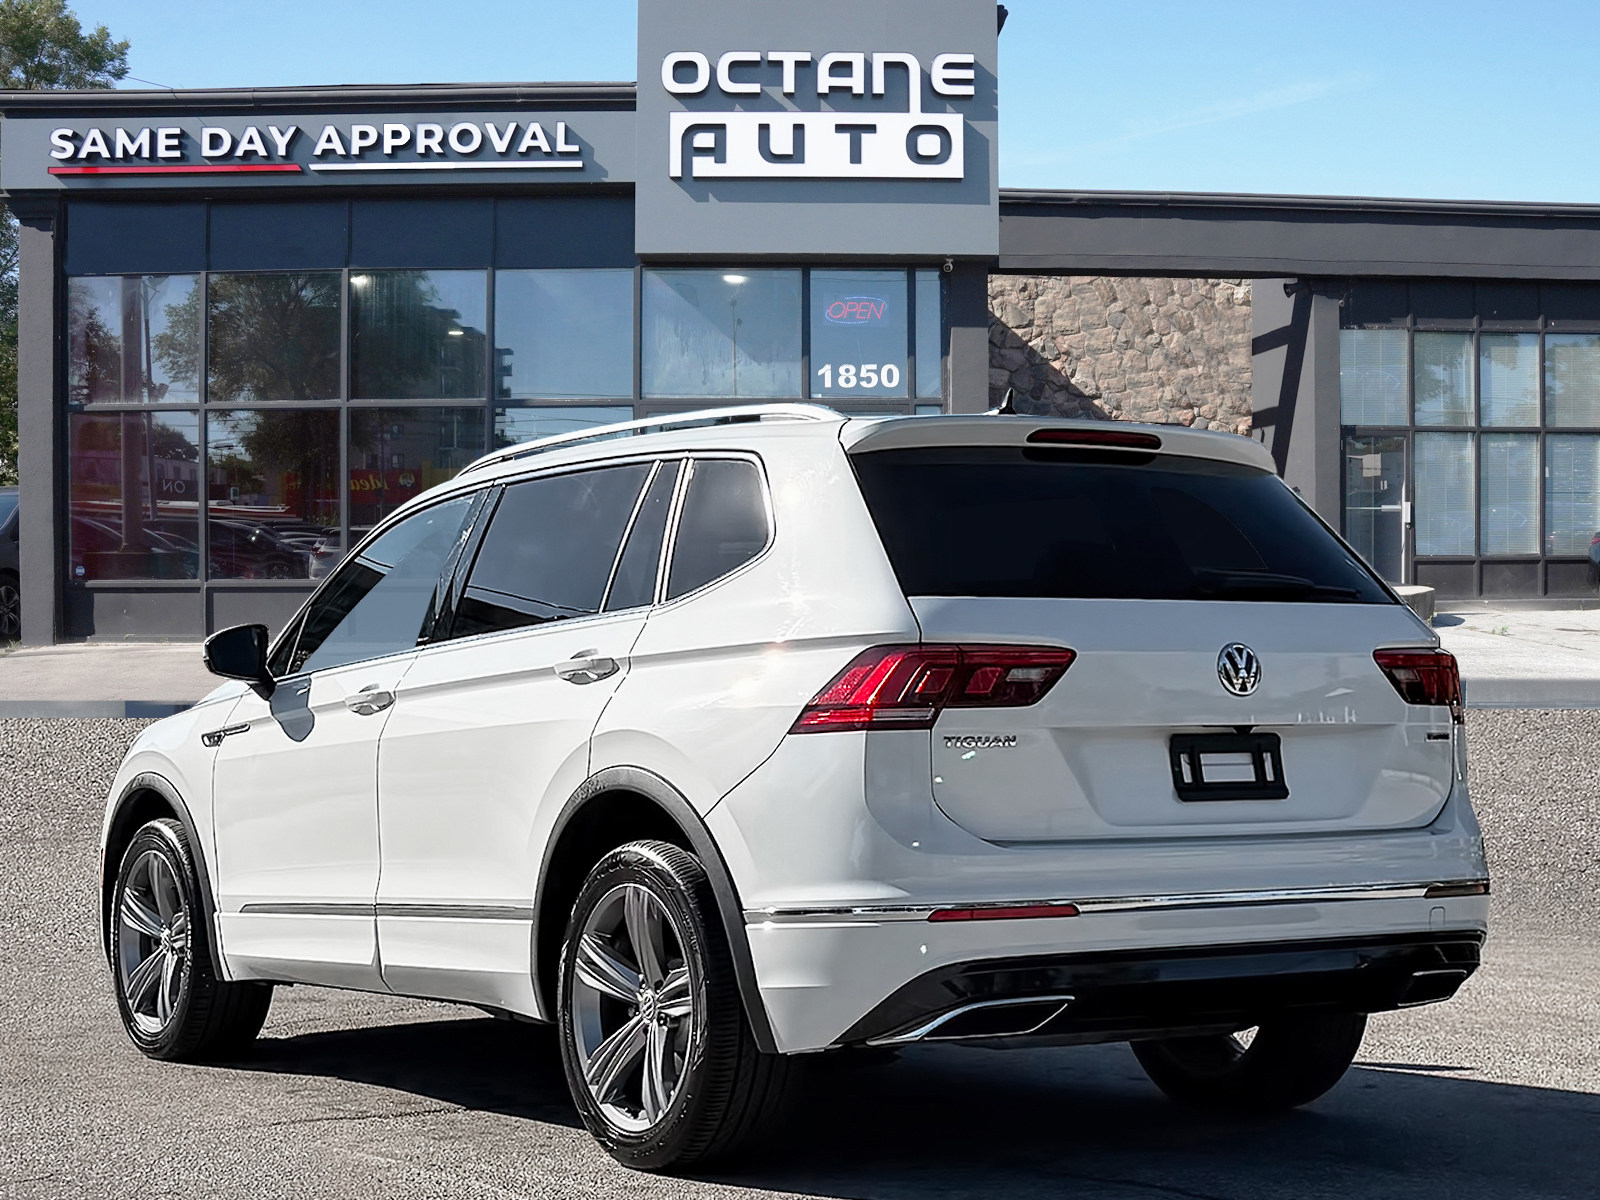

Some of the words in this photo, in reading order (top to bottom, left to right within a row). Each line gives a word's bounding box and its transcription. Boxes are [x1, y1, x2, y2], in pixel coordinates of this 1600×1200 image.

[661, 51, 975, 112] OCTANE
[49, 127, 181, 159] SAME
[201, 125, 297, 157] DAY
[312, 121, 580, 156] APPROVAL
[681, 123, 952, 177] AUTO
[829, 302, 885, 319] OPEN
[817, 364, 900, 388] 1850
[943, 735, 1017, 748] TIGUAN
